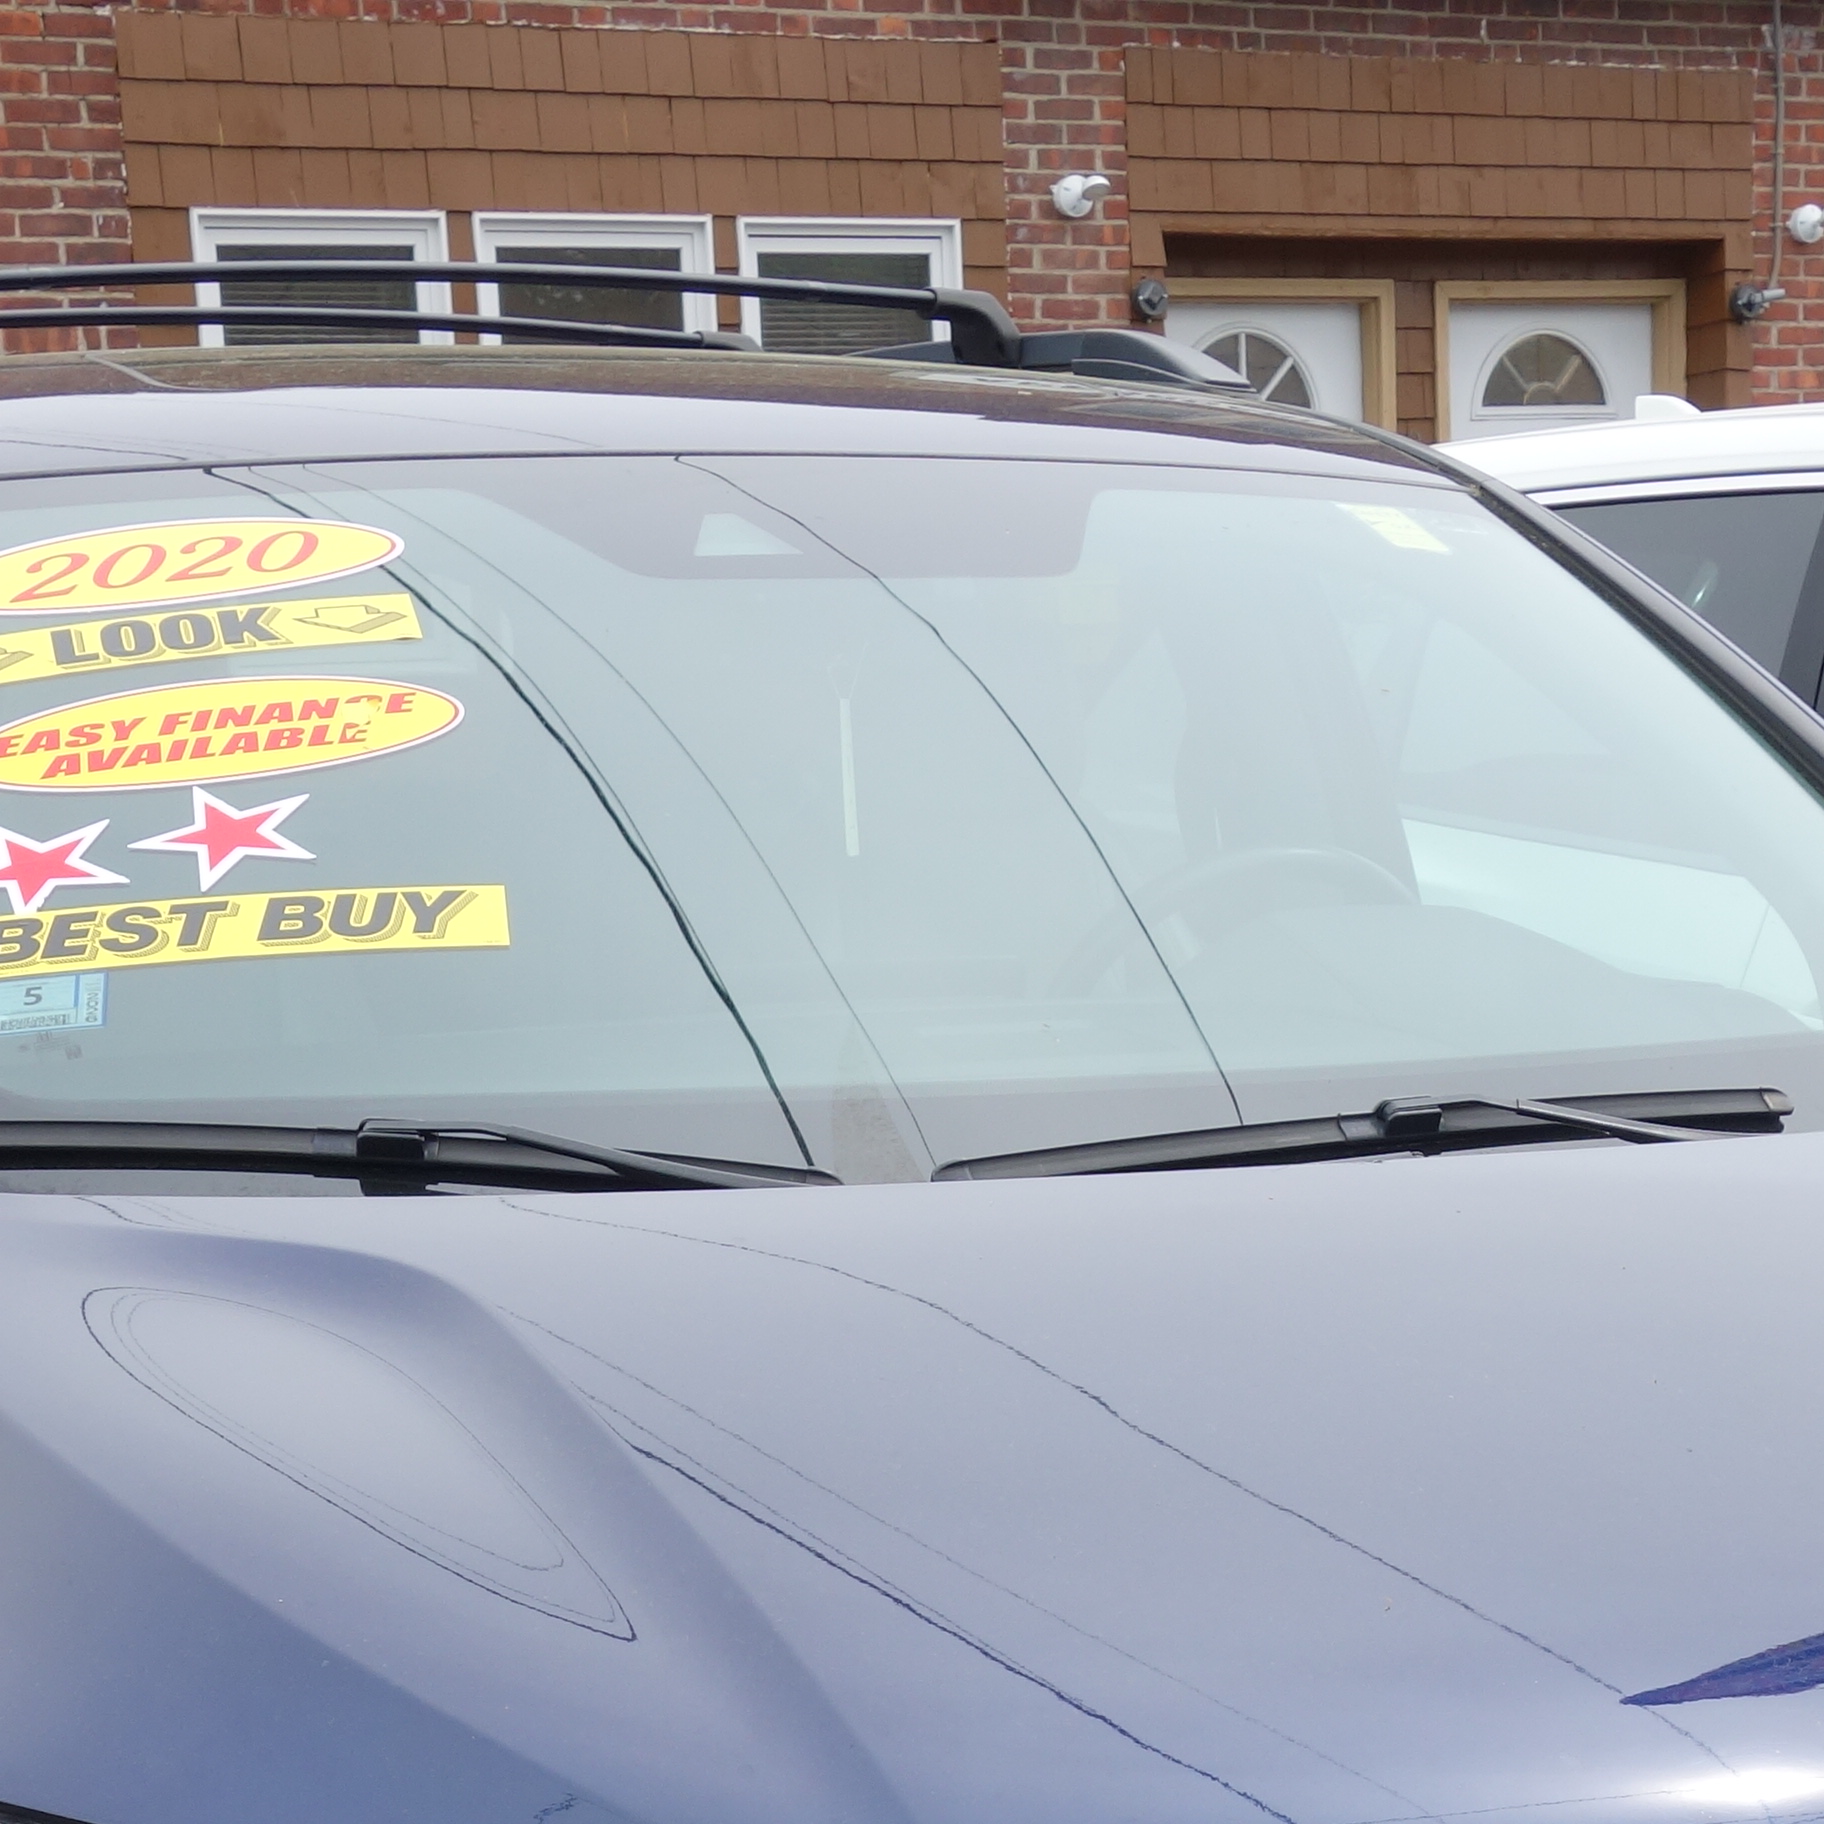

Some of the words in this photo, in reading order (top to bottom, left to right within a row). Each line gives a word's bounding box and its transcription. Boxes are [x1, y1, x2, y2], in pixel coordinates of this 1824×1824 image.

[10, 530, 320, 603] 2020
[50, 606, 279, 668] LOOK
[40, 722, 370, 780] AVAILABLE
[257, 889, 474, 948] BUY
[23, 985, 43, 1006] 5
